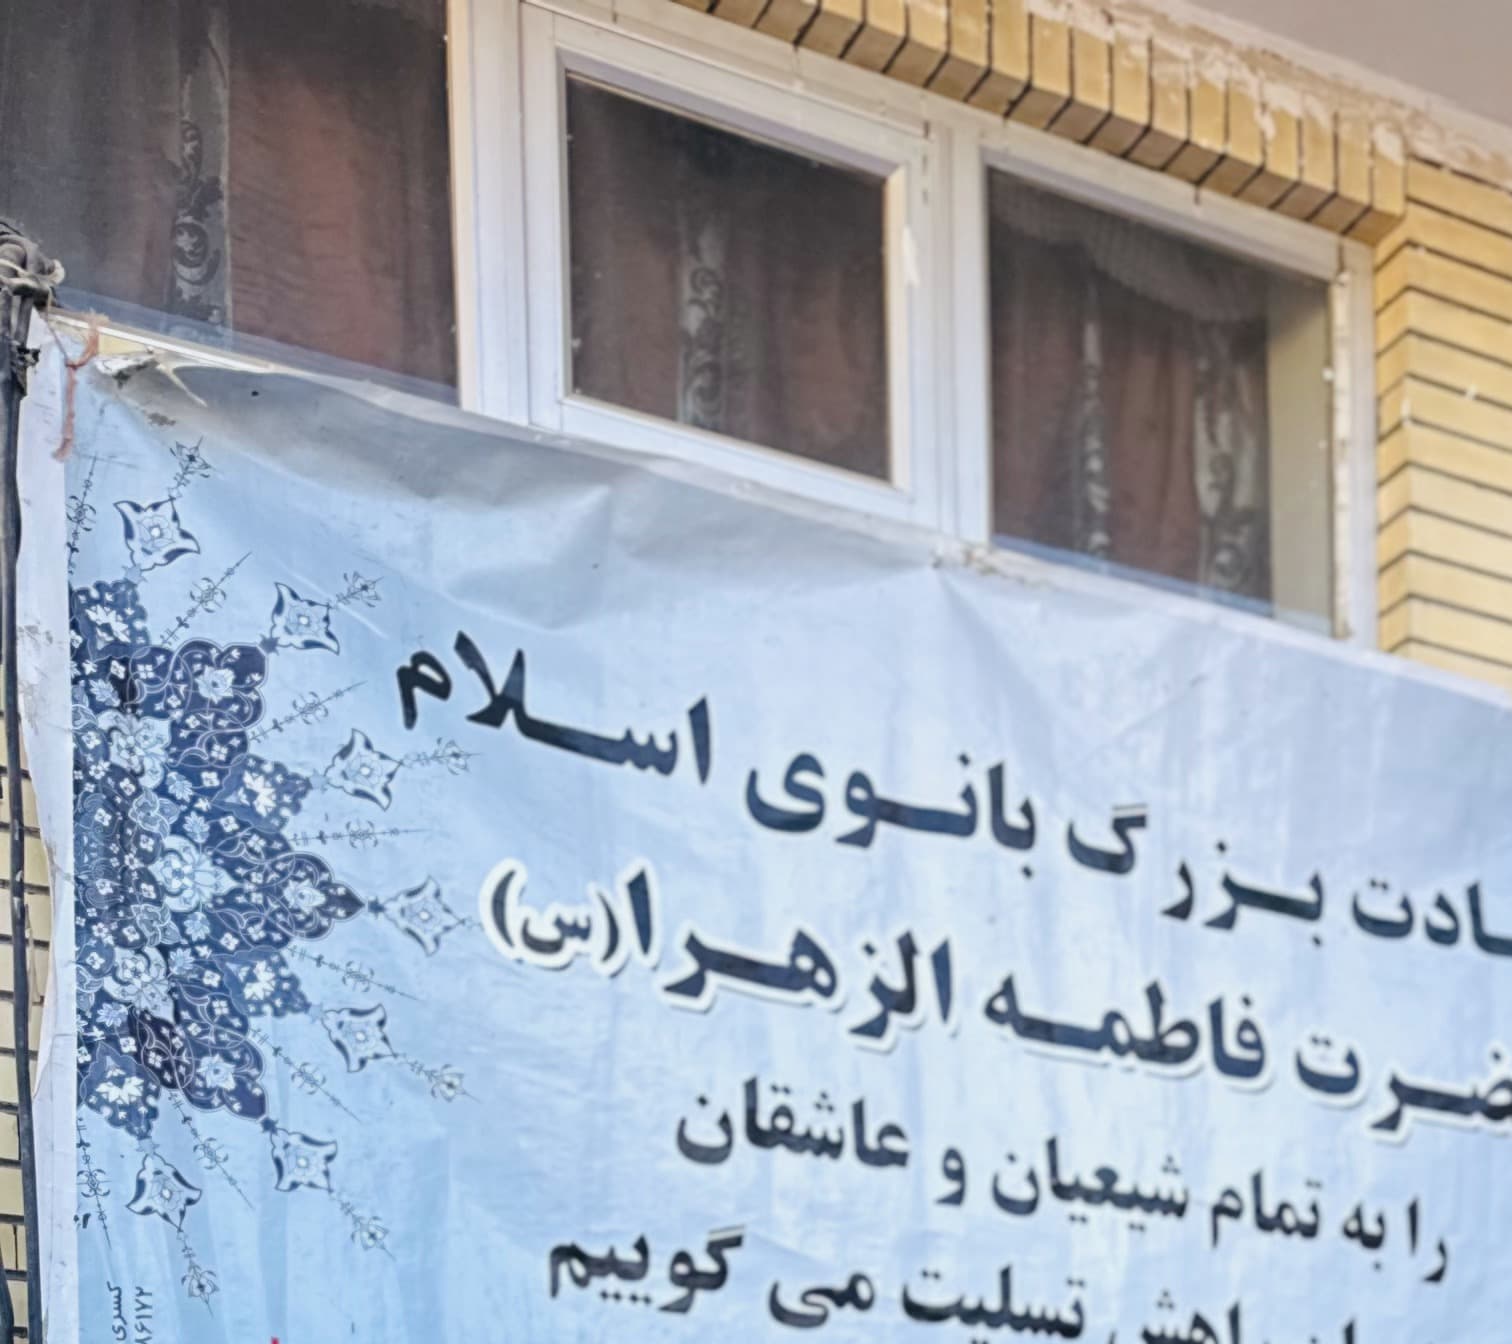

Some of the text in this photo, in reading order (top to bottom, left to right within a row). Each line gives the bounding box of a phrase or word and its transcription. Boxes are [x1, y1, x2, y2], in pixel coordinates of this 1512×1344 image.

[395, 628, 713, 786] اسلام
[744, 750, 1037, 880] بانوی
[1064, 801, 1326, 946] بزرگ
[983, 974, 1266, 1080] فاطمه
[676, 1077, 1448, 1285] را به تمام شیعیان و عاشقان
[548, 1225, 744, 1315] گوییم
[767, 1266, 876, 1330] می
